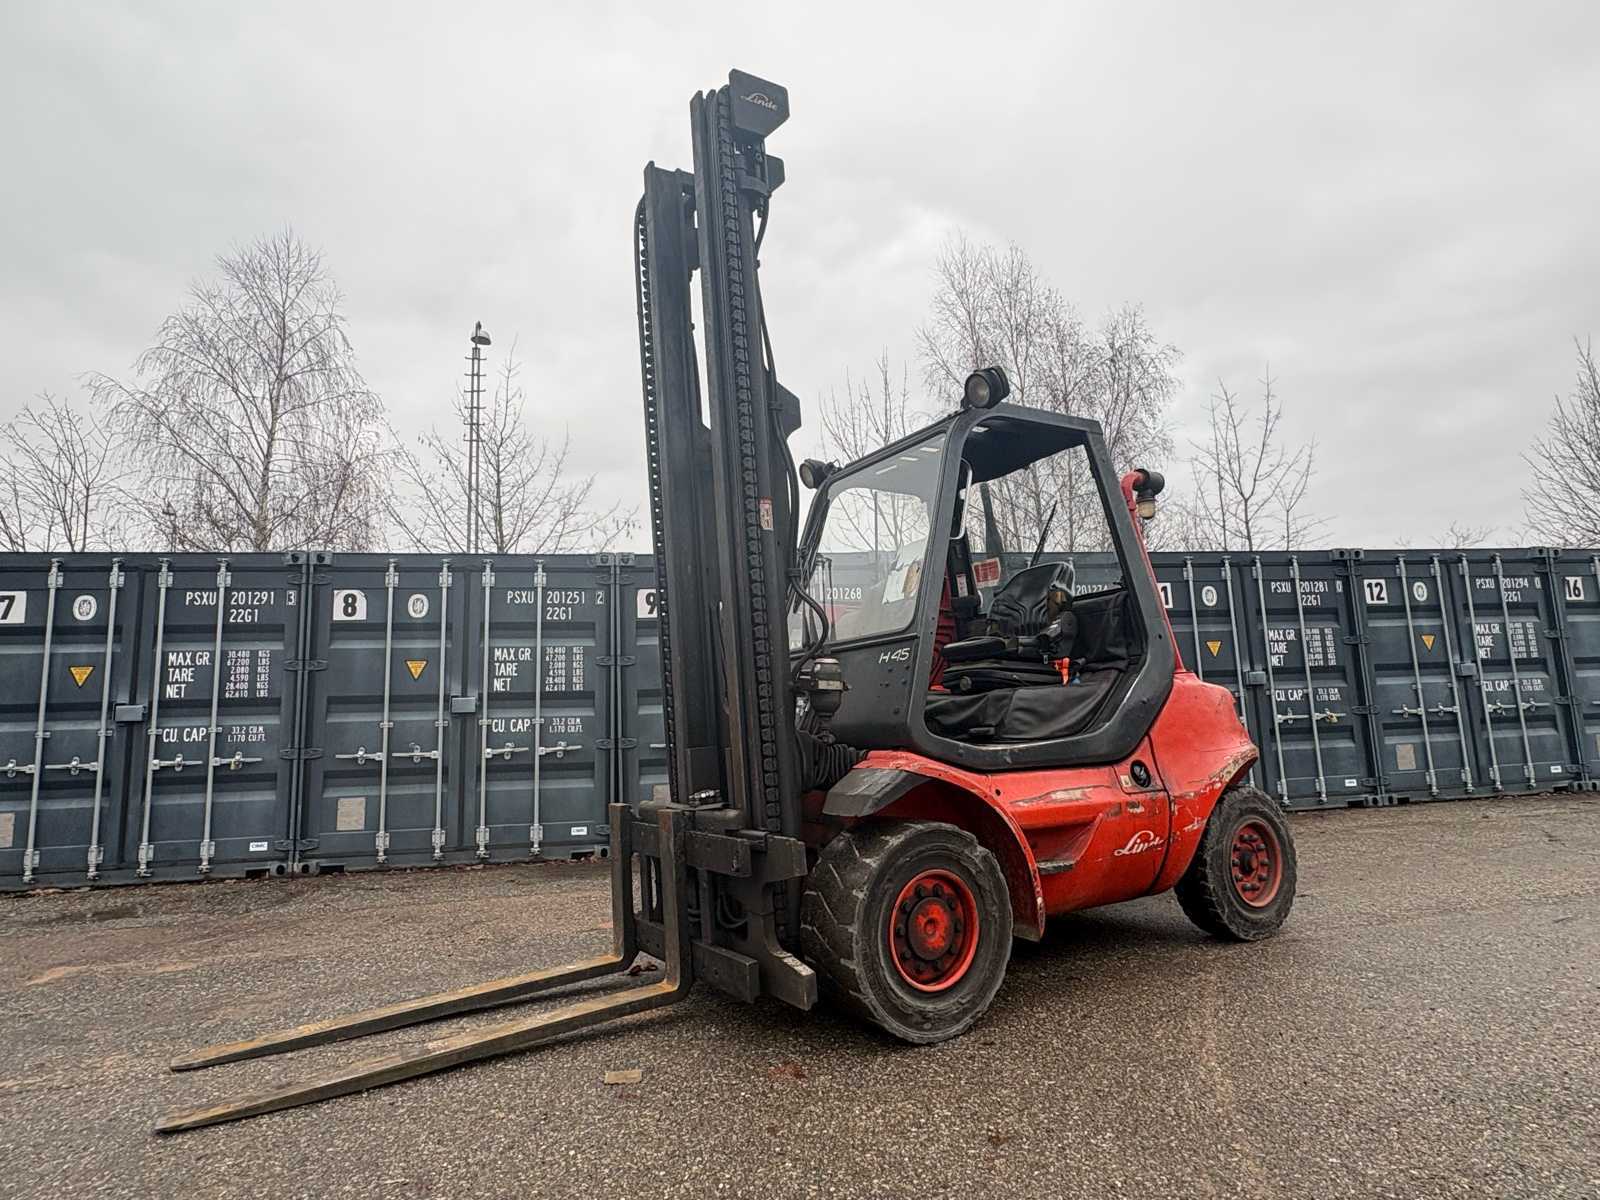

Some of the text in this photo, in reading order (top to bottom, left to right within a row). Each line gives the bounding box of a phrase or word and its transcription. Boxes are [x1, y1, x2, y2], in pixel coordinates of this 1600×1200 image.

[740, 92, 778, 111] Linde
[826, 588, 862, 600] 201268
[1271, 581, 1292, 593] PSXU
[1300, 581, 1329, 593] 201281
[1366, 582, 1385, 601] 12
[1566, 579, 1582, 598] 16
[185, 590, 296, 606] PSXU 201291 3
[507, 591, 604, 604] PSXU 201251 2
[645, 592, 657, 615] 9
[1302, 594, 1321, 606] 22G1
[0, 595, 16, 620] 7
[343, 593, 357, 617] 8
[229, 609, 258, 622] 22G1
[546, 607, 572, 620] 22G1
[1477, 635, 1495, 646] TARE
[1270, 642, 1288, 654] TARE
[1478, 647, 1491, 659] NET
[1271, 655, 1284, 667] NET
[168, 668, 195, 682] TARE
[494, 662, 518, 676] TARE
[166, 684, 187, 698] NET
[493, 678, 511, 691] NET
[510, 718, 531, 732] CAP.
[183, 727, 208, 742] CAP.
